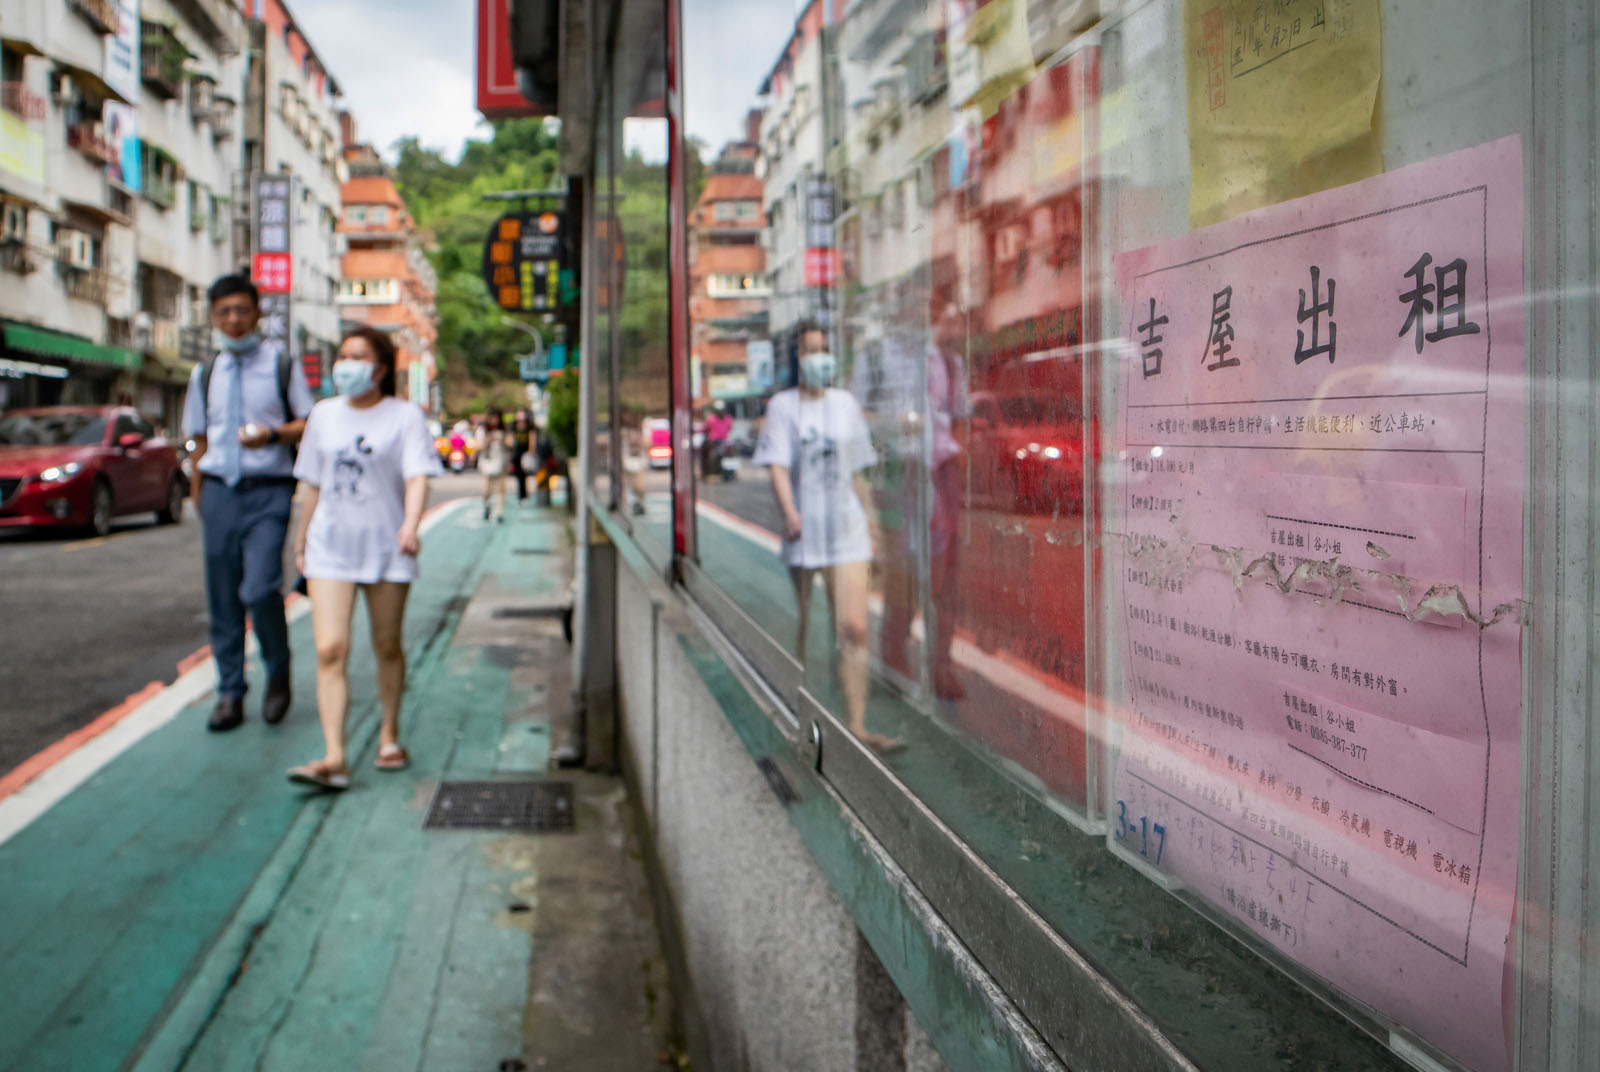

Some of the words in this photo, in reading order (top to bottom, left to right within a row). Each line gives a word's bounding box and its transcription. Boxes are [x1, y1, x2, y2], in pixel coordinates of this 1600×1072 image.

[1138, 252, 1481, 380] 吉屋出租
[1116, 800, 1166, 865] 3-17
[1339, 809, 1371, 838] 冷氣機
[1383, 828, 1418, 861] 電視機
[1432, 851, 1472, 886] 電冰箱
